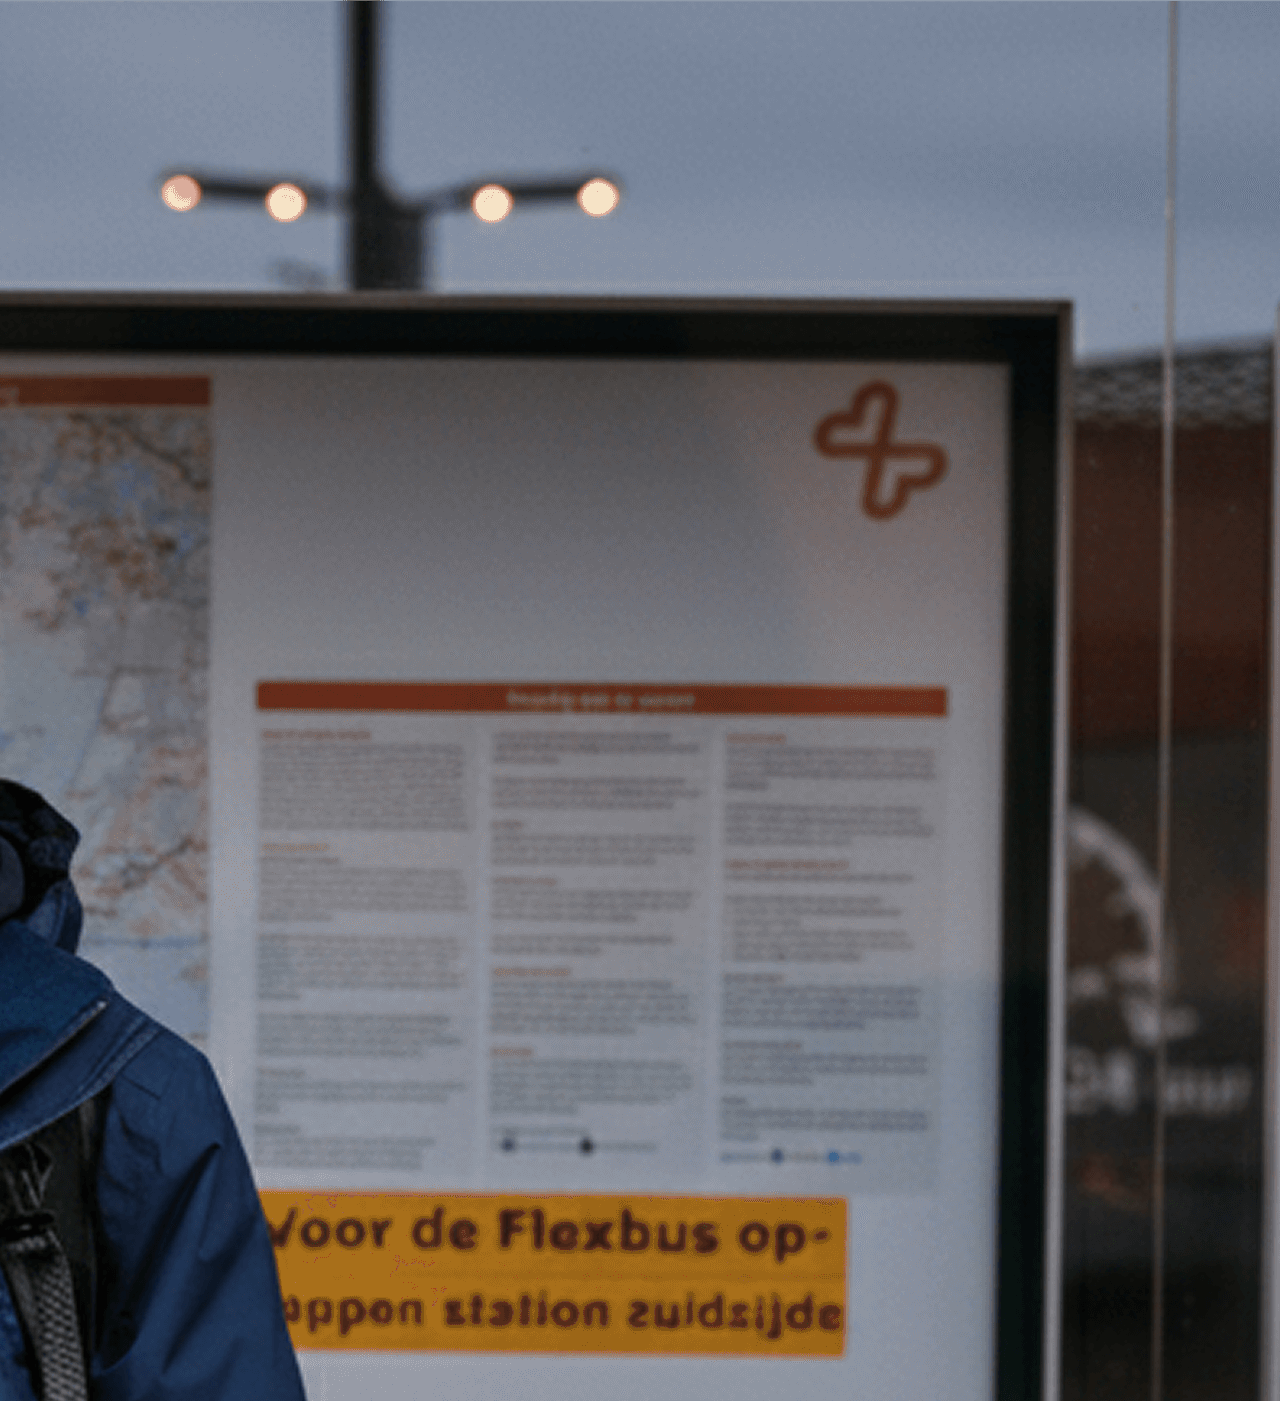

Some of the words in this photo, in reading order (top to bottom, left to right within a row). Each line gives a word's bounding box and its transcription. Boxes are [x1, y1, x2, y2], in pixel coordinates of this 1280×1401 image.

[411, 1206, 478, 1251] de
[498, 1208, 719, 1255] Flexbus
[738, 1222, 832, 1263] op-
[444, 1294, 610, 1329] station
